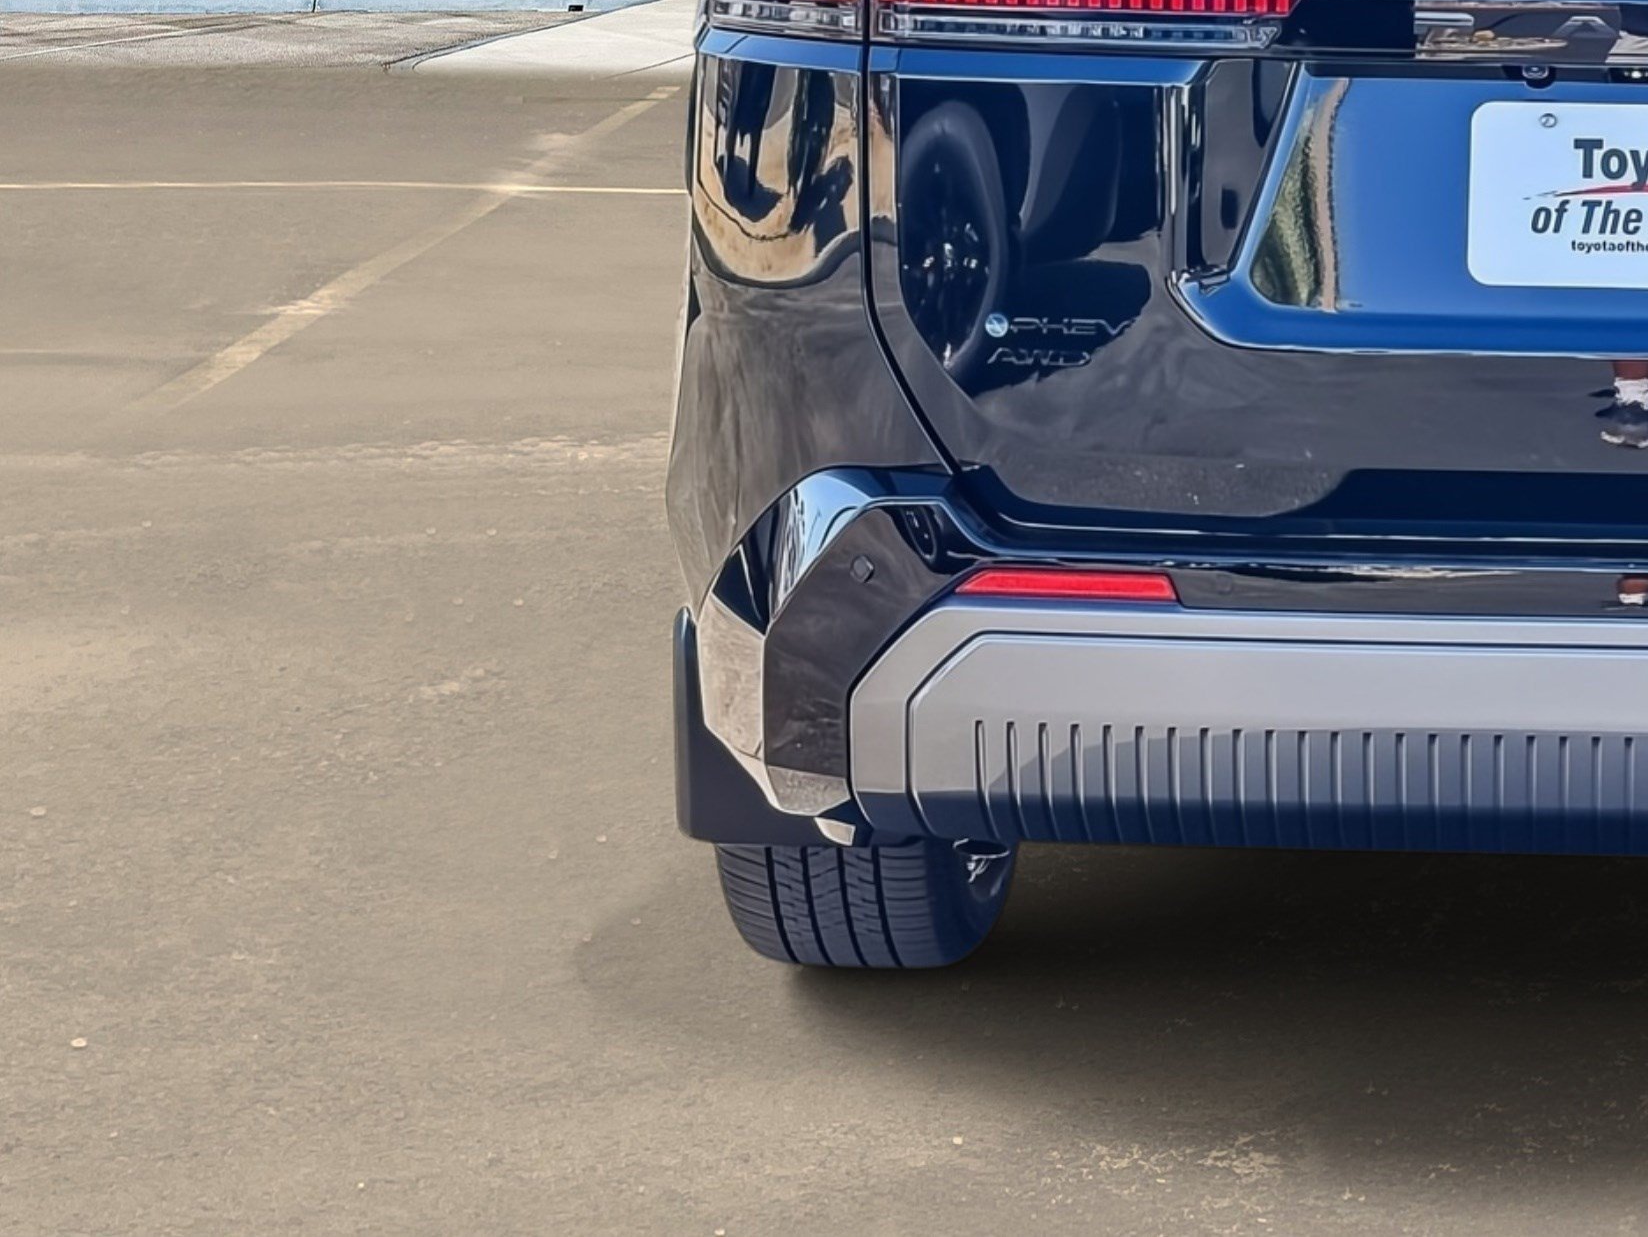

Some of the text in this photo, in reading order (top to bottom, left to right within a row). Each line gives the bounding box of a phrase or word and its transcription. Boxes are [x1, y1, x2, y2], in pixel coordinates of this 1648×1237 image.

[1531, 199, 1568, 234] of
[1580, 200, 1643, 235] The
[986, 346, 1092, 367] AWD
